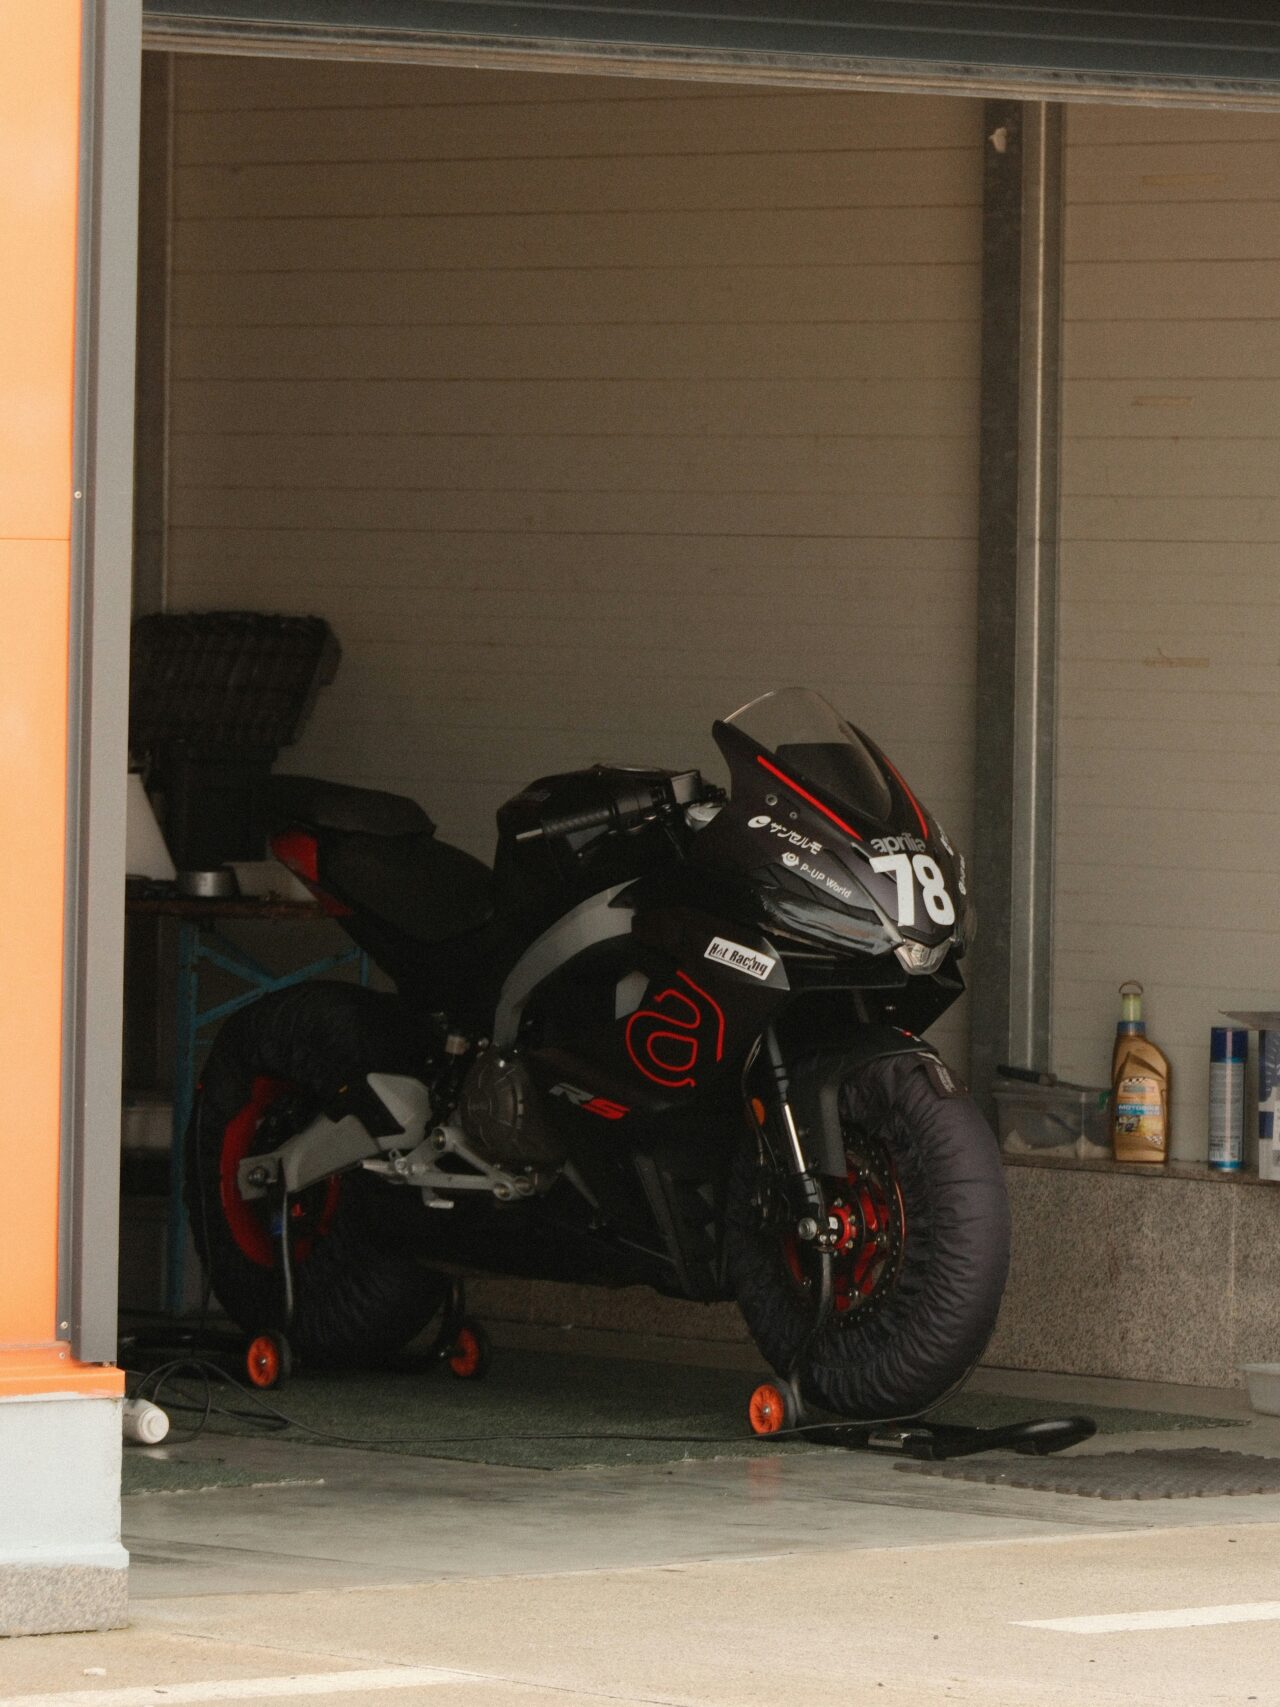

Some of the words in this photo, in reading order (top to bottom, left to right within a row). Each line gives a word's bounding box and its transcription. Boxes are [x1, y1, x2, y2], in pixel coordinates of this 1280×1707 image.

[770, 822, 823, 855] サンセルモ
[870, 832, 927, 856] aprilia
[800, 862, 826, 881] P-UP
[826, 876, 852, 898] World
[868, 853, 956, 927] 78
